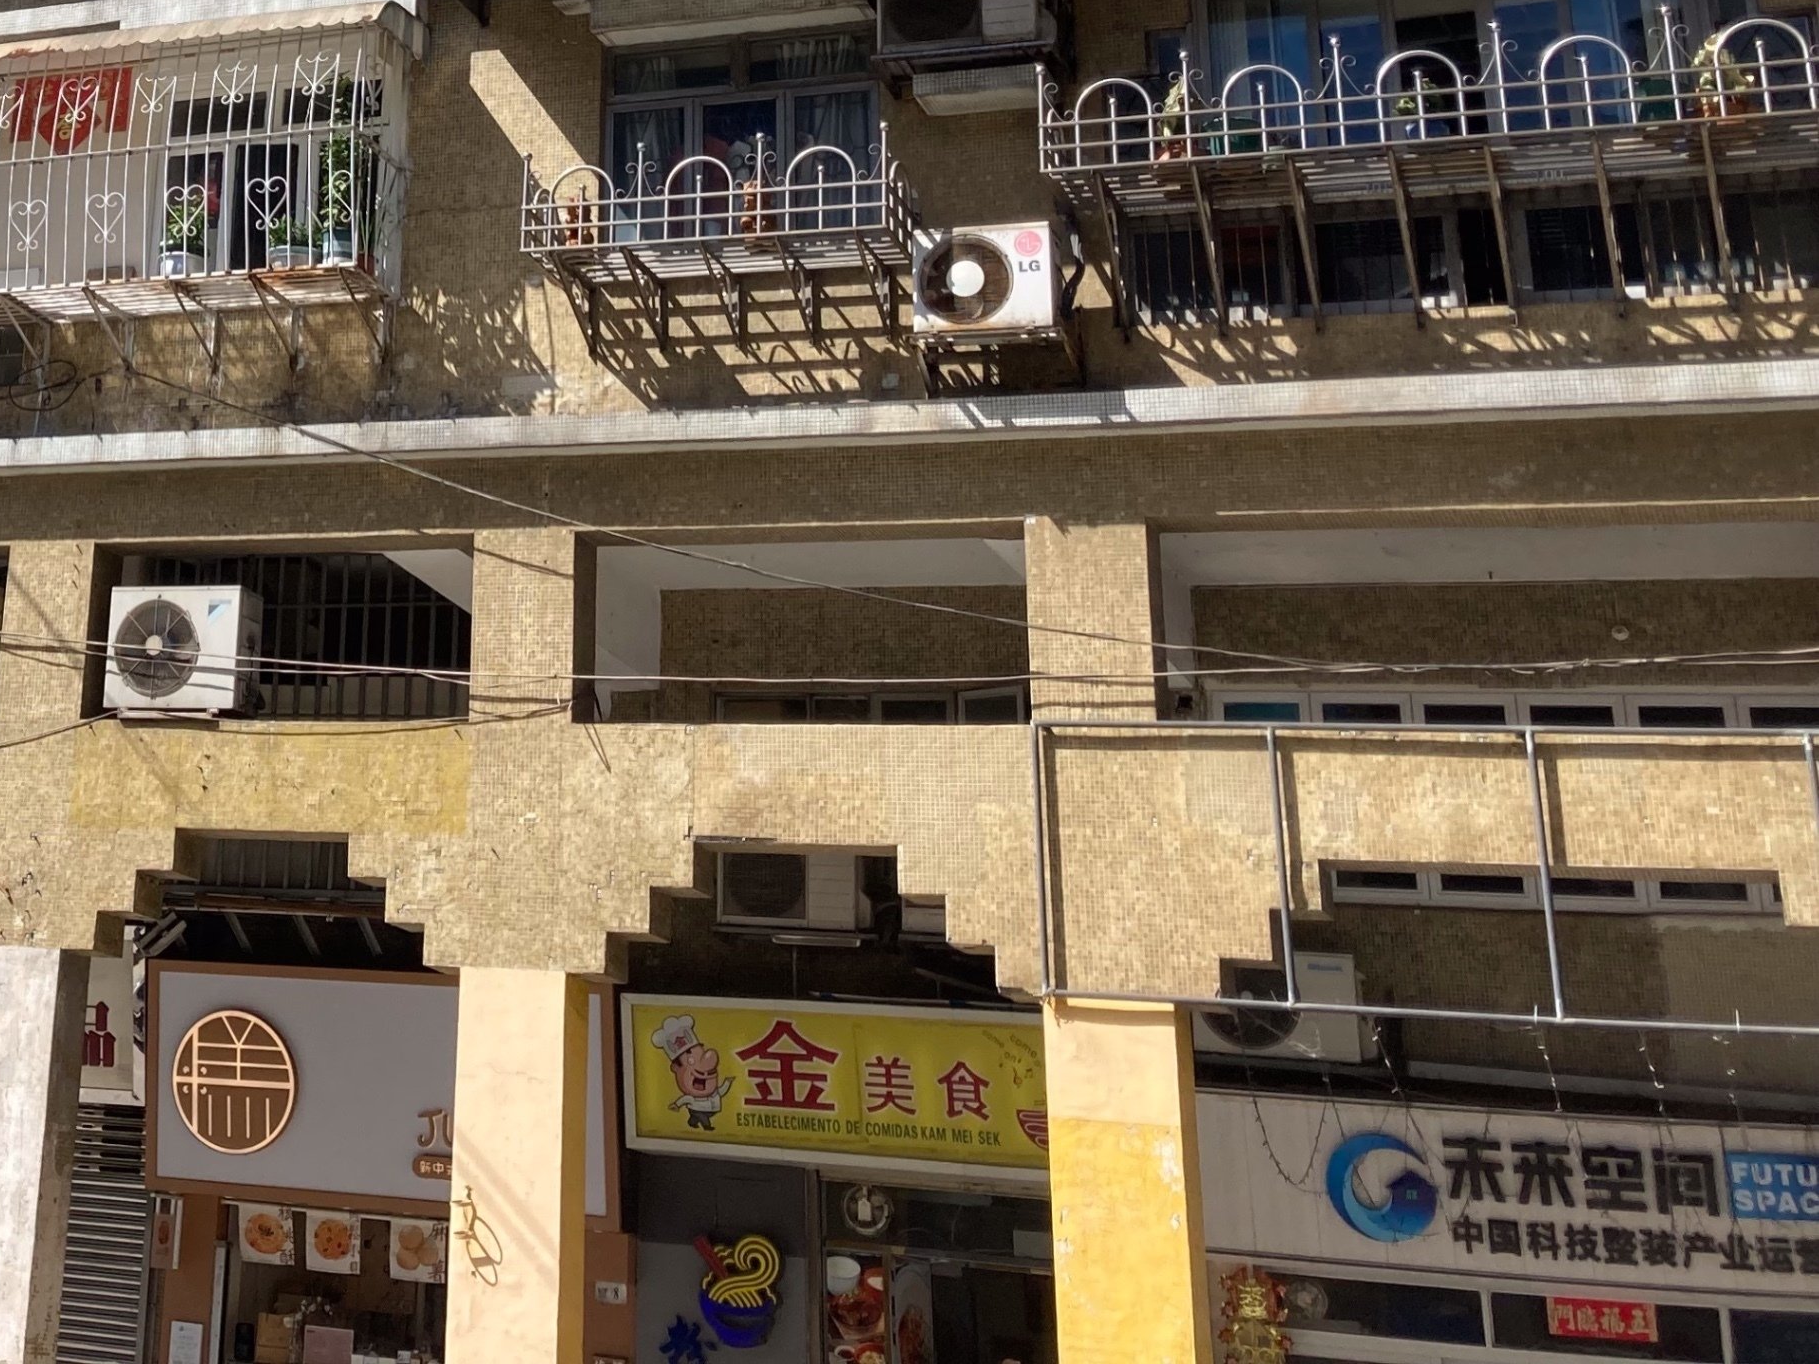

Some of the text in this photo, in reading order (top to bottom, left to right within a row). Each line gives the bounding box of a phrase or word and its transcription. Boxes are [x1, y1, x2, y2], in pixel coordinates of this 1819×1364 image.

[1018, 259, 1041, 273] LG
[735, 1019, 991, 1122] 金美食
[736, 1112, 1002, 1147] ESTABELECIMENTO DE COMIDAS KAM MEI SEK
[1441, 1136, 1721, 1217] 未来空间
